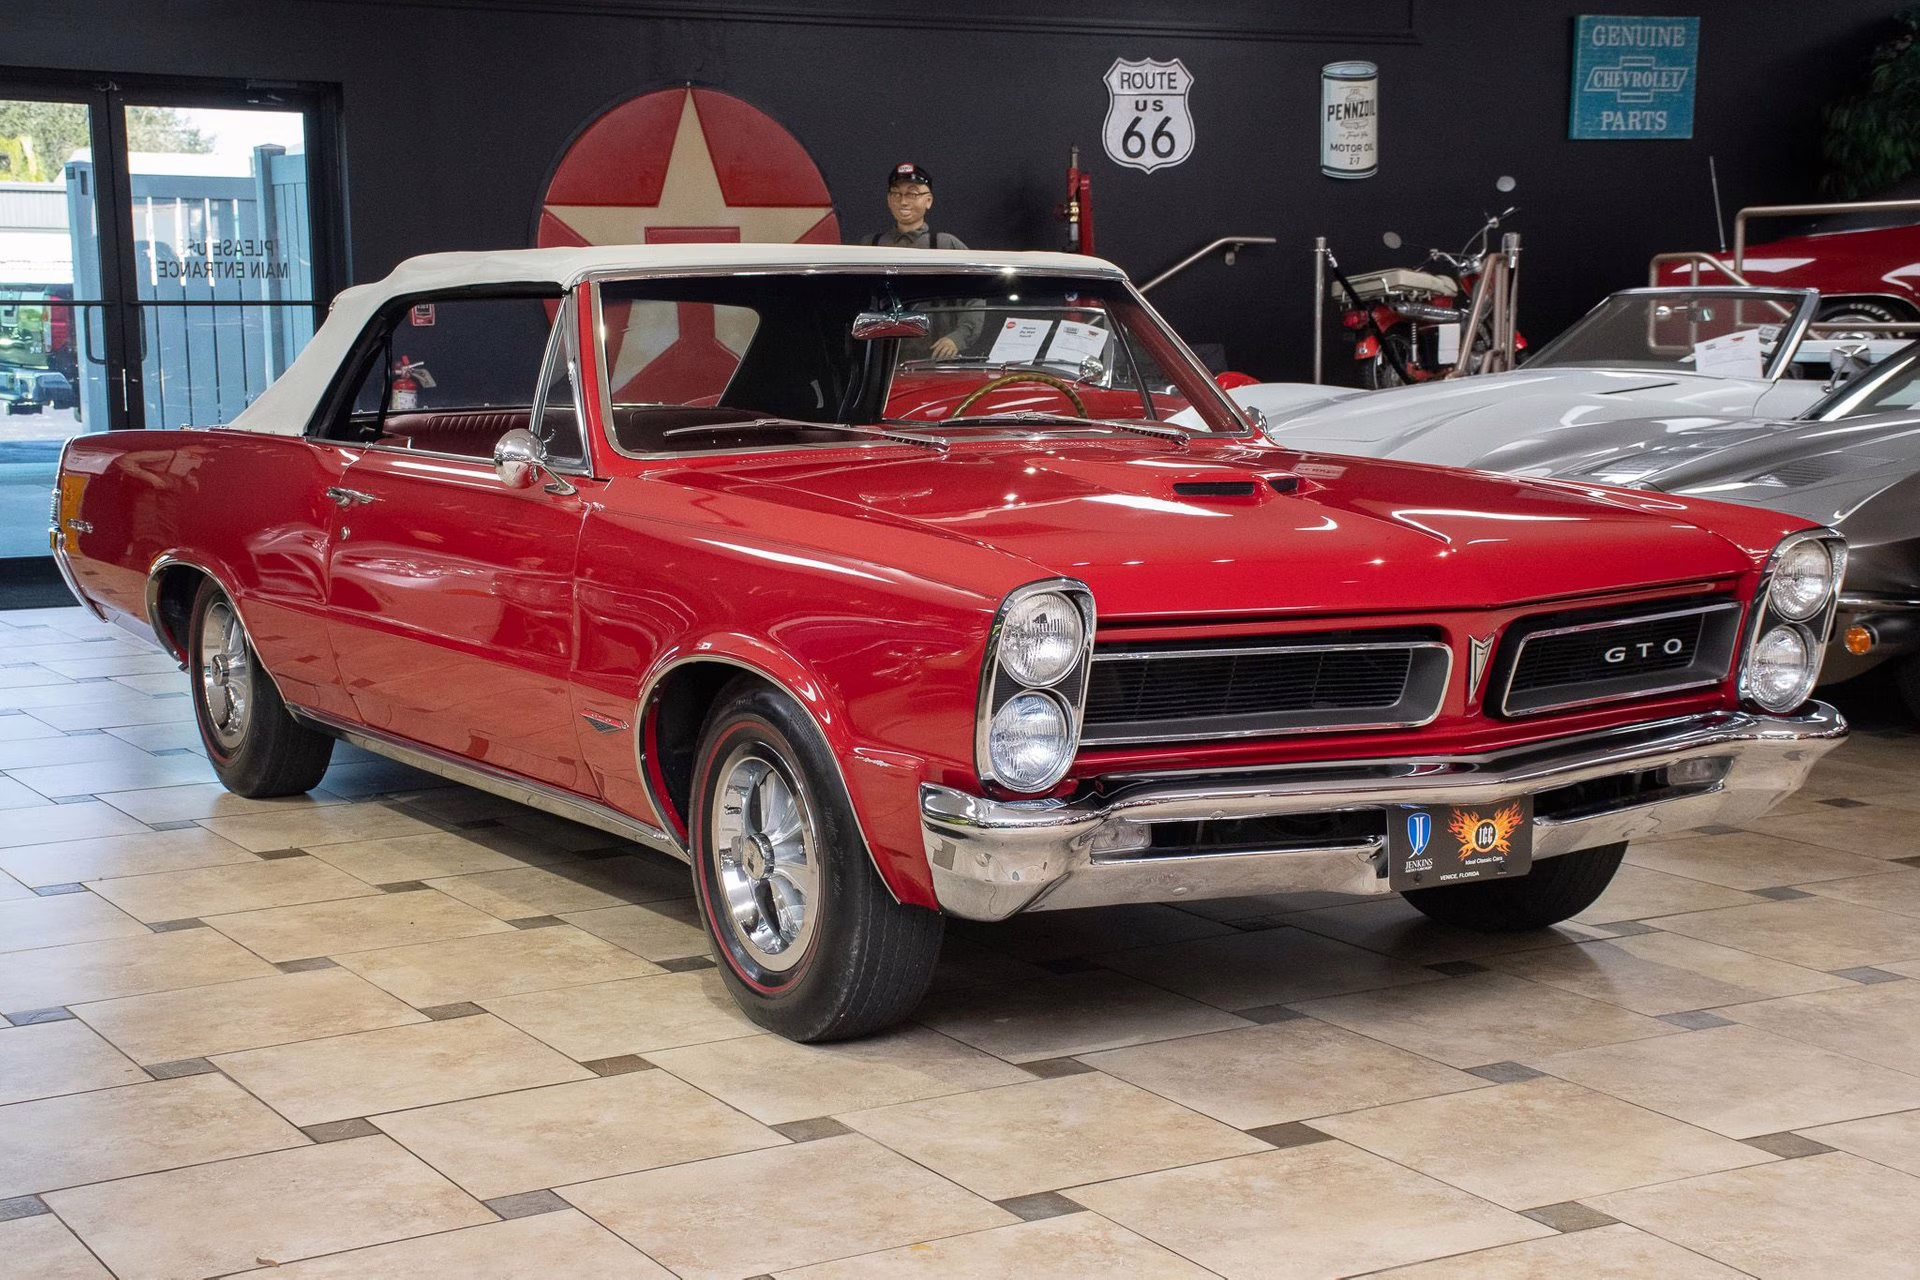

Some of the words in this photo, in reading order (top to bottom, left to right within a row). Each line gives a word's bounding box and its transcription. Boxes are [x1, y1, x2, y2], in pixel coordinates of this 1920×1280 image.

[1592, 25, 1686, 47] GENUINE
[1120, 72, 1177, 89] ROUTE
[1593, 71, 1681, 88] CHEVROLET
[1135, 100, 1164, 112] US
[1601, 110, 1668, 131] PARTS
[1122, 116, 1175, 158] 66
[1330, 143, 1362, 153] MOTOR
[1604, 638, 1683, 663] GTO
[1405, 858, 1433, 869] JENKINS
[1459, 870, 1480, 879] FLORIDA
